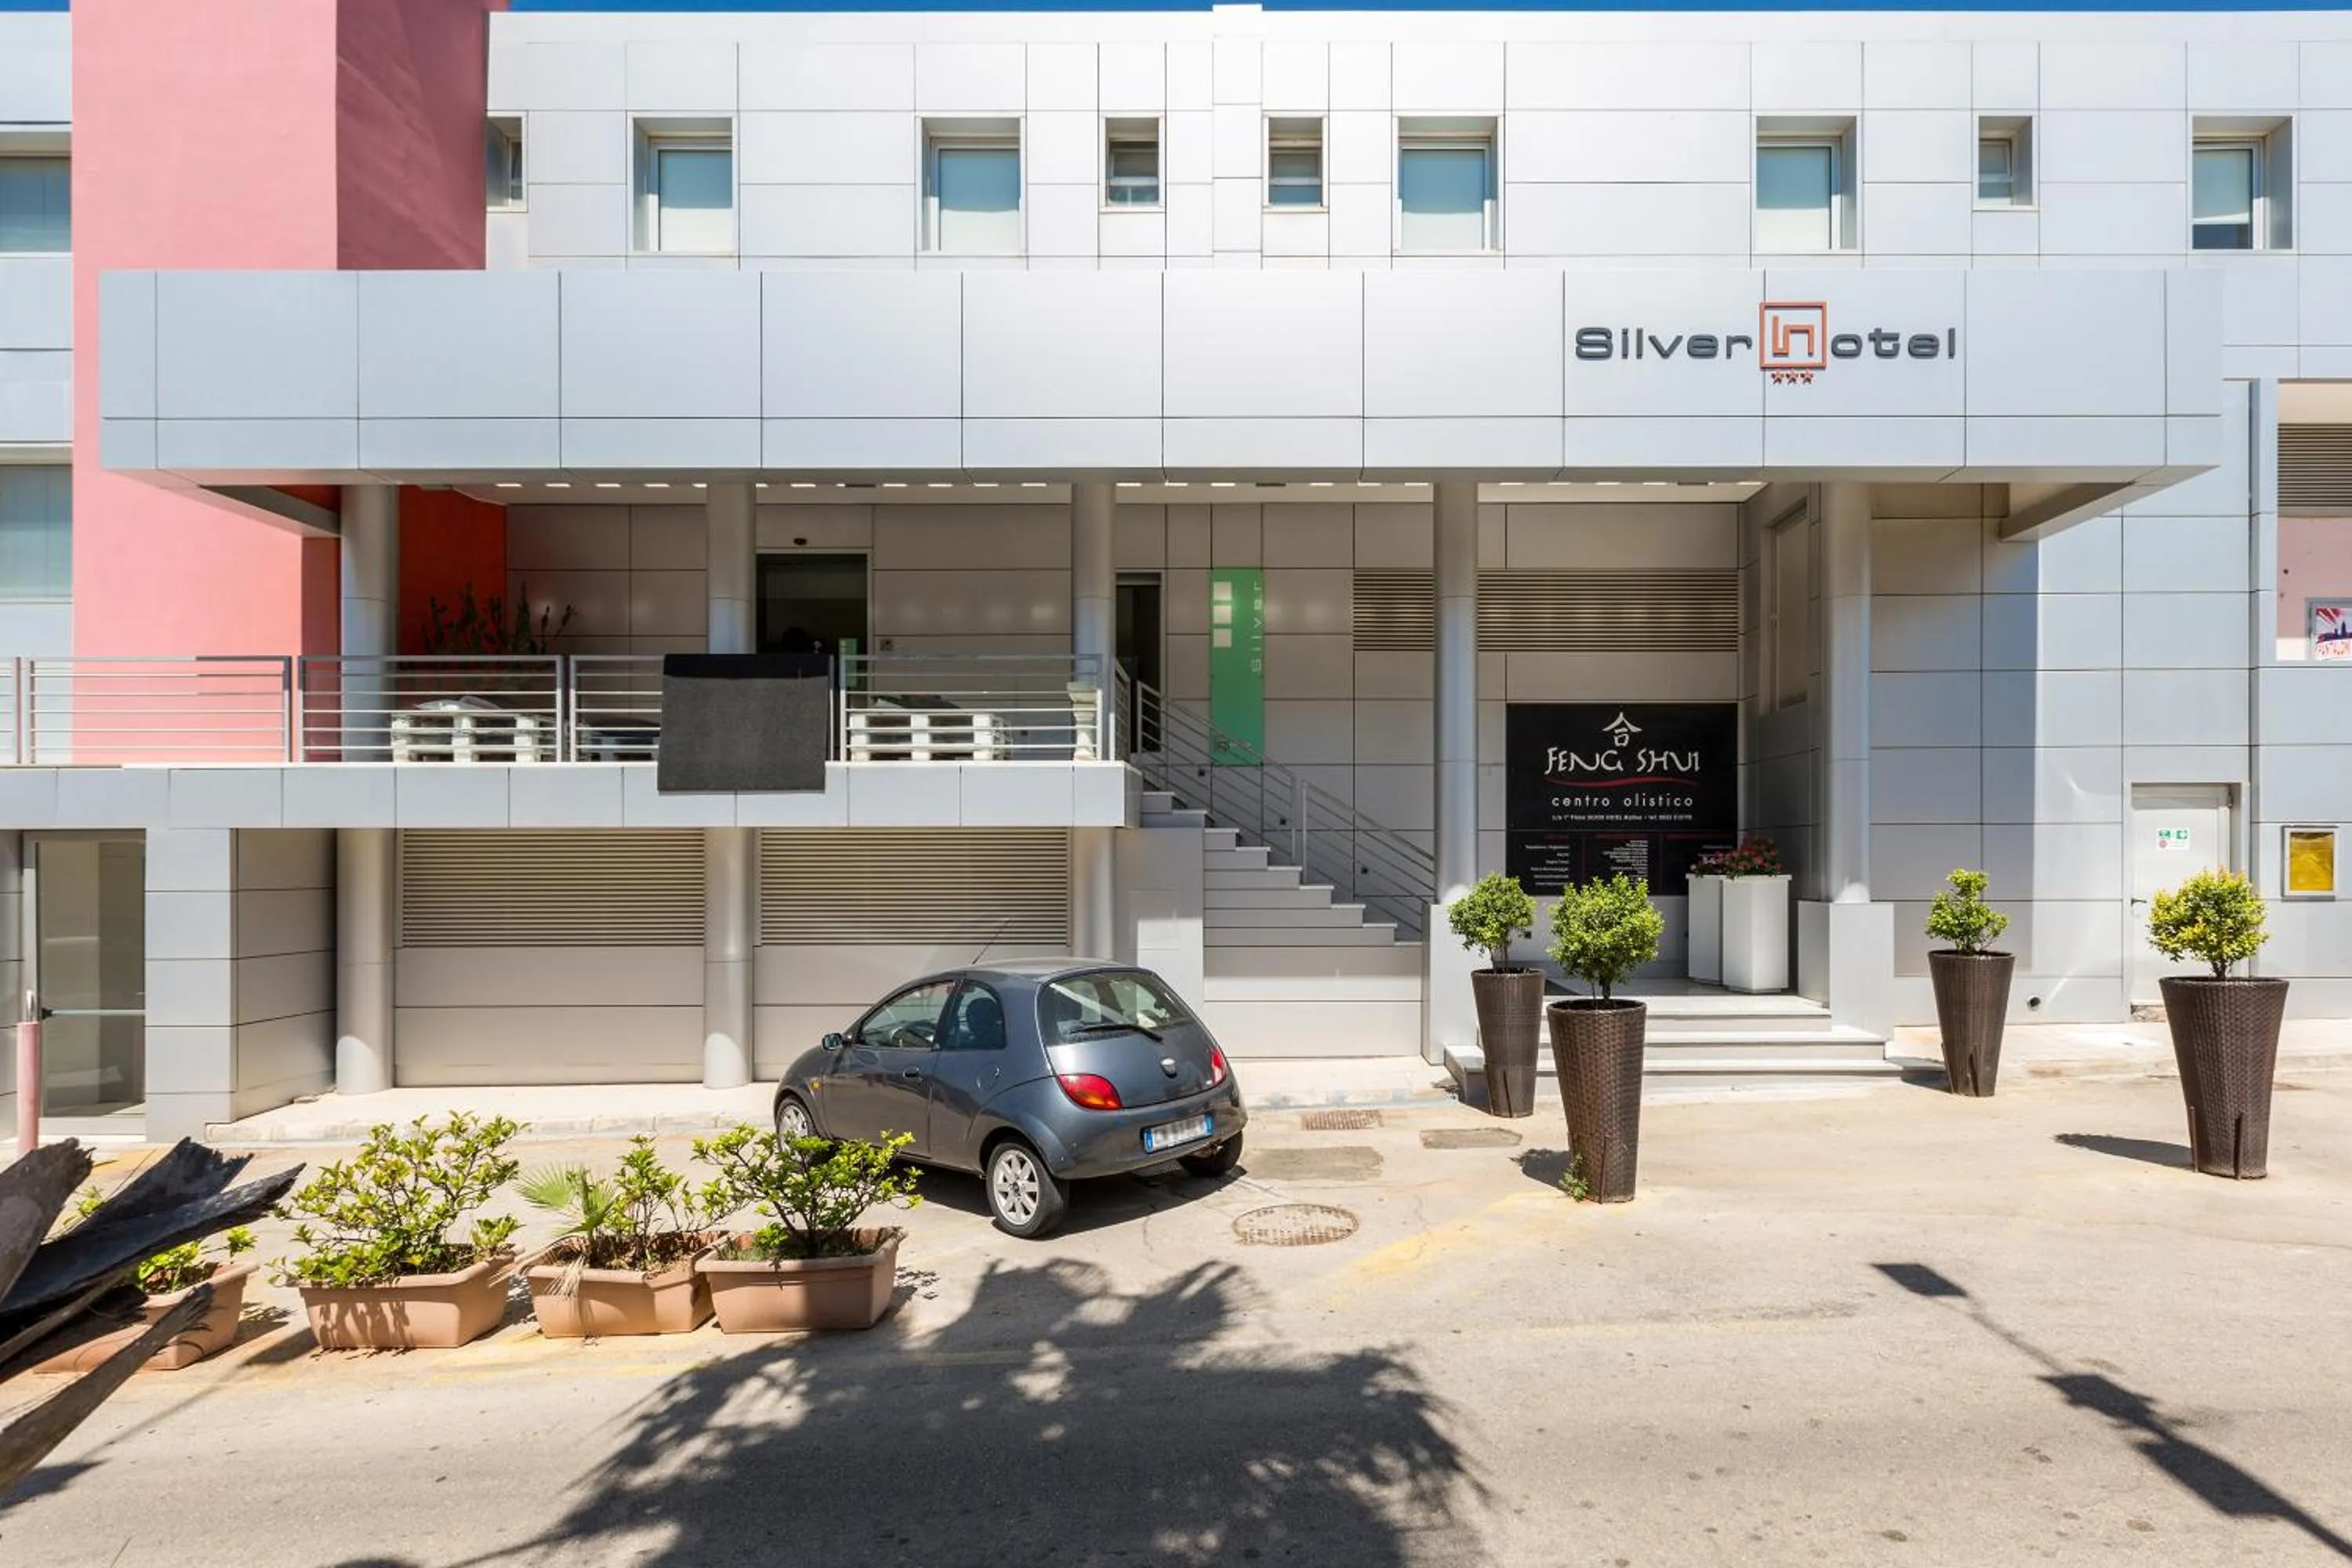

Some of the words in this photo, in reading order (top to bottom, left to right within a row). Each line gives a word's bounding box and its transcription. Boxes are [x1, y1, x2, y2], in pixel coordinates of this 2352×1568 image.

[1575, 327, 1753, 360] Silver
[1251, 581, 1262, 673] Silver
[1544, 746, 1624, 775] FENG
[1636, 748, 1700, 772] SHUI
[1552, 795, 1610, 807] centro
[1624, 793, 1693, 807] olistico
